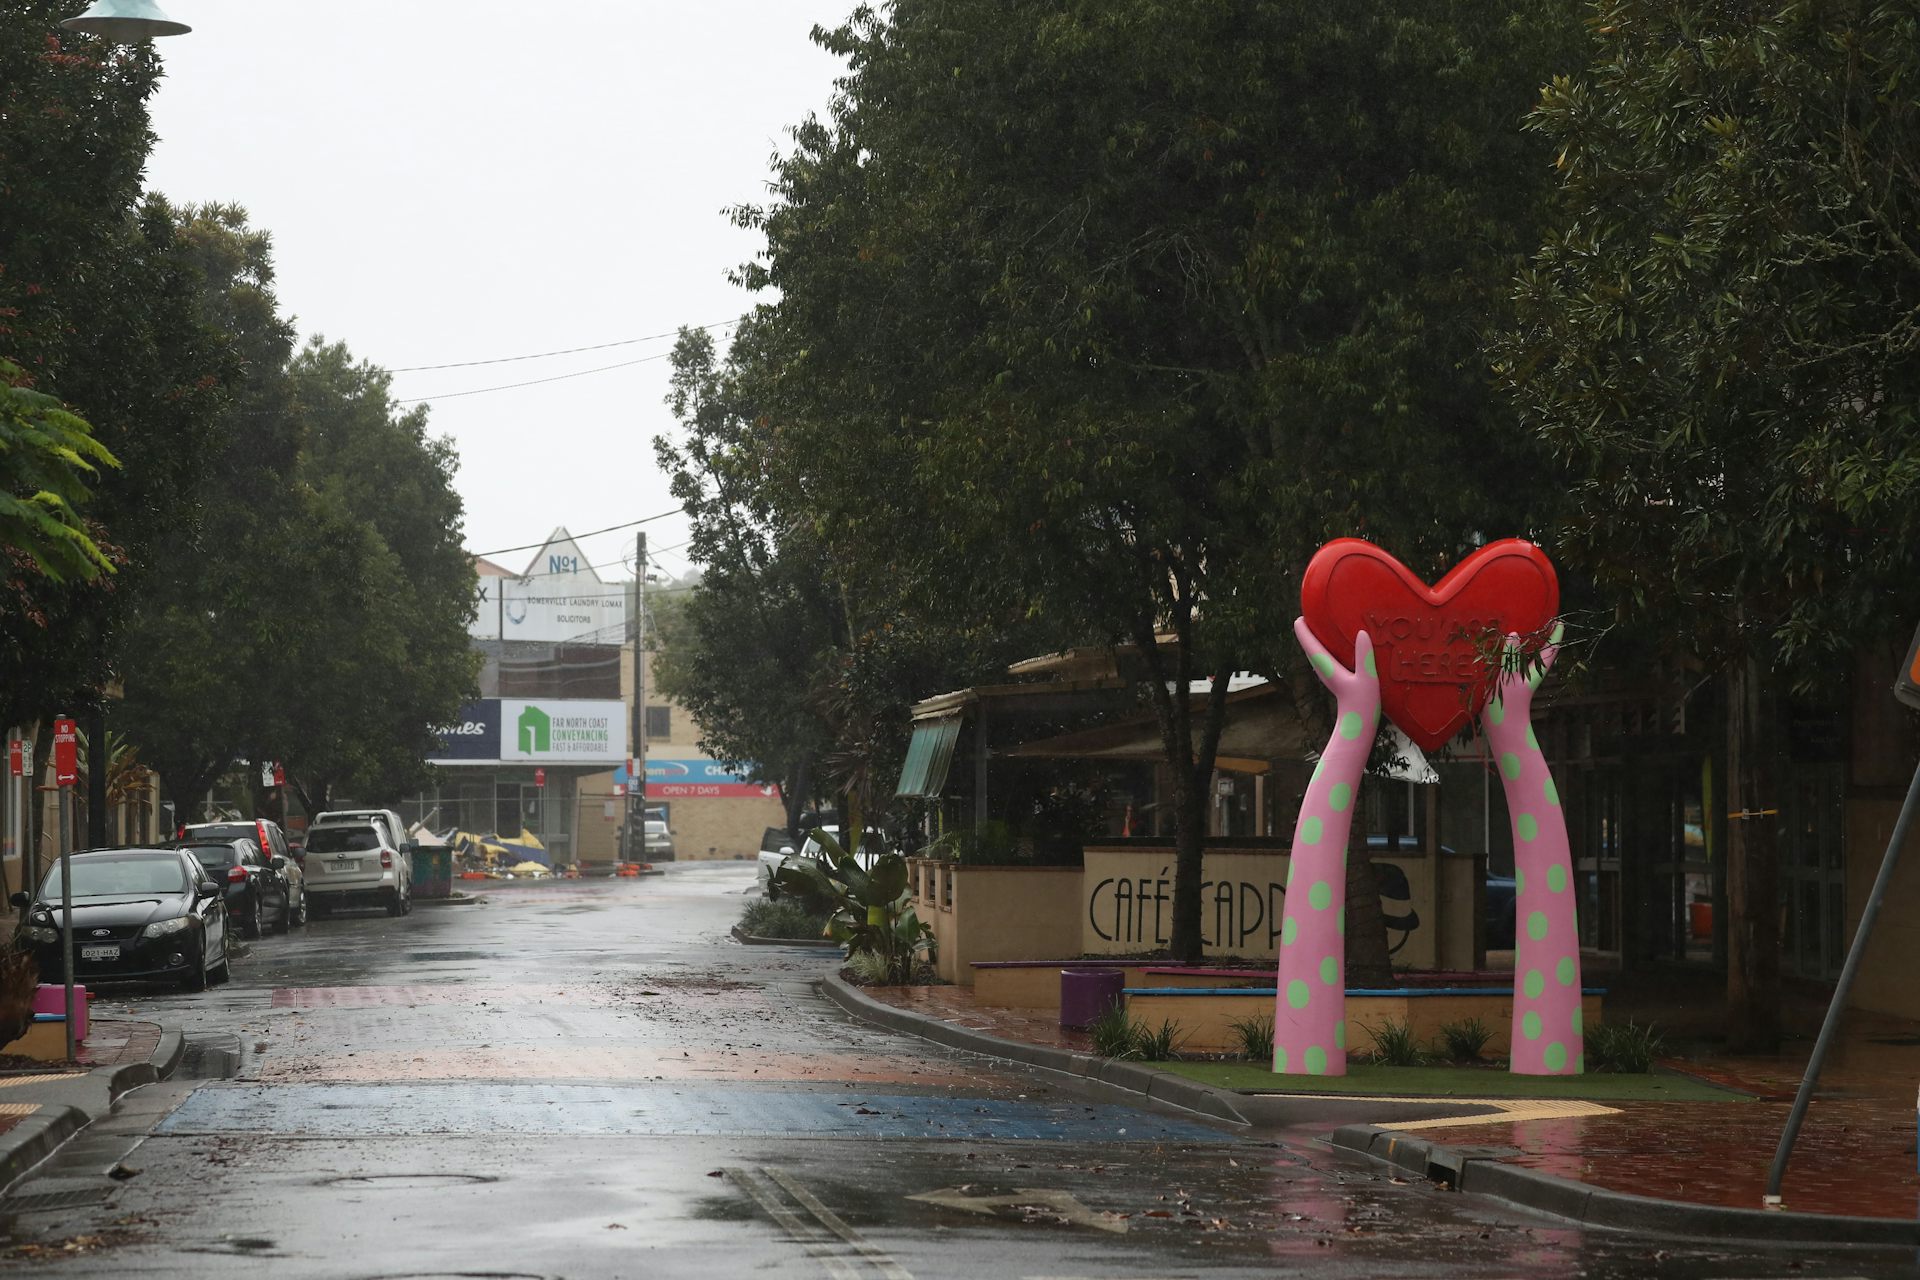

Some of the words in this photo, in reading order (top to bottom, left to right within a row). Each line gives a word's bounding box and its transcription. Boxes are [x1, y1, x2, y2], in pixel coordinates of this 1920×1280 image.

[528, 596, 567, 606] SOMERVILLE
[569, 598, 599, 608] LAUNDRY
[601, 600, 622, 608] LOMAX
[557, 615, 591, 624] SOLICITORS
[1399, 649, 1474, 677] HERE
[552, 718, 564, 728] FAR
[566, 718, 587, 728] NORTH
[588, 717, 608, 728] COAST
[60, 725, 69, 733] NO
[55, 734, 76, 743] STOPPING
[552, 729, 608, 741] CONVEYANCING
[23, 743, 32, 752] 2P
[552, 742, 566, 752] FAST
[573, 742, 608, 752] AFFORDABLE
[662, 786, 687, 795] OPEN
[697, 786, 719, 795] DAYS
[1089, 866, 1170, 944] CAFÉ
